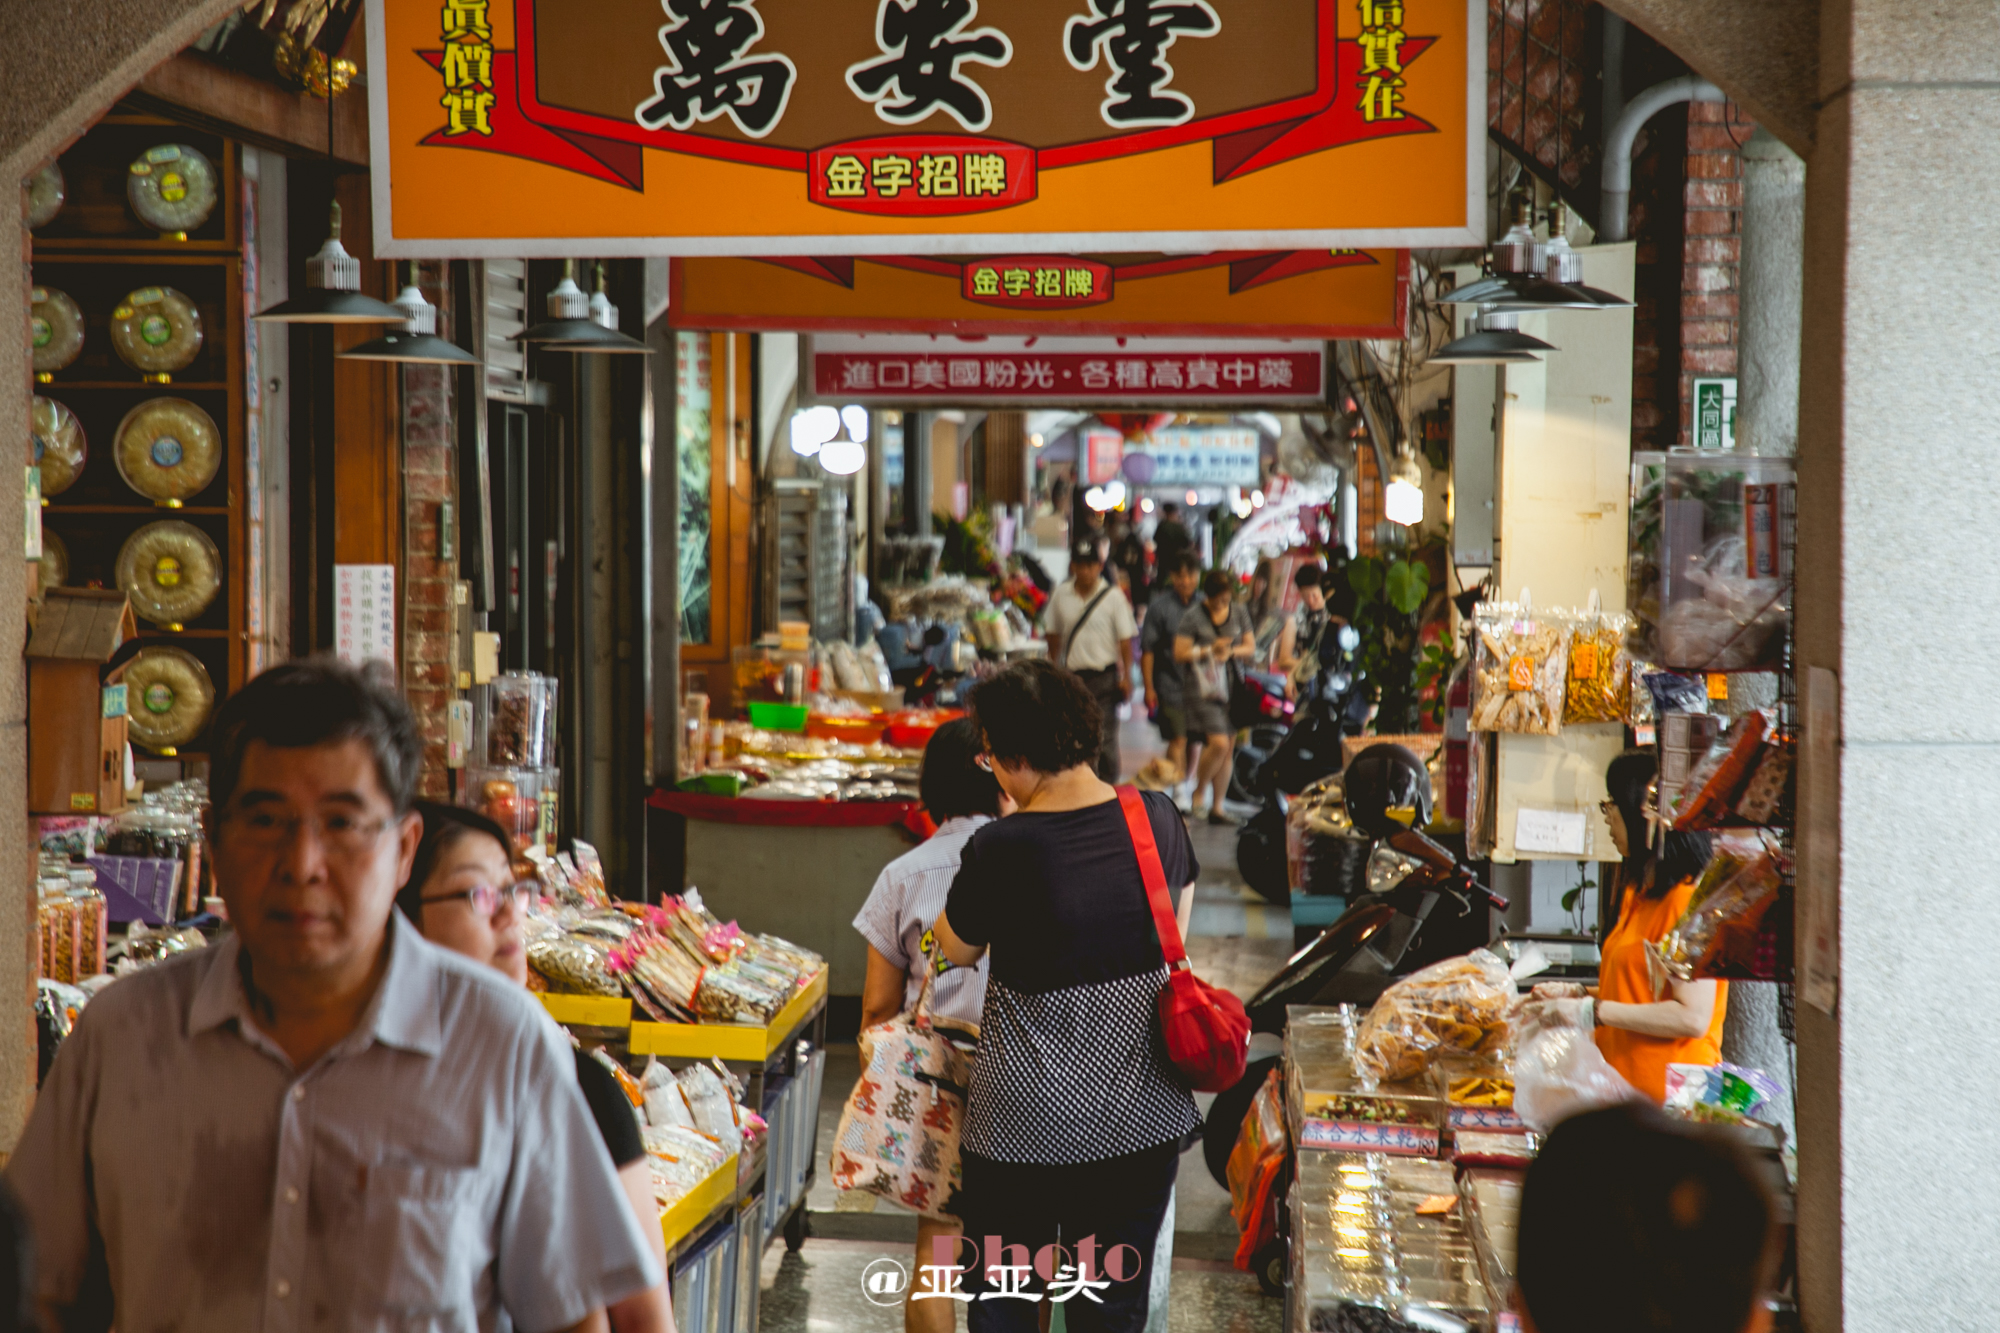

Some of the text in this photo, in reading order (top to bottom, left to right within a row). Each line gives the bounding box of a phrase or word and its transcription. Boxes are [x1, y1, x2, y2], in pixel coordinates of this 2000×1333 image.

[826, 153, 1006, 197] 金字招牌
[973, 267, 1093, 297] 金字招牌
